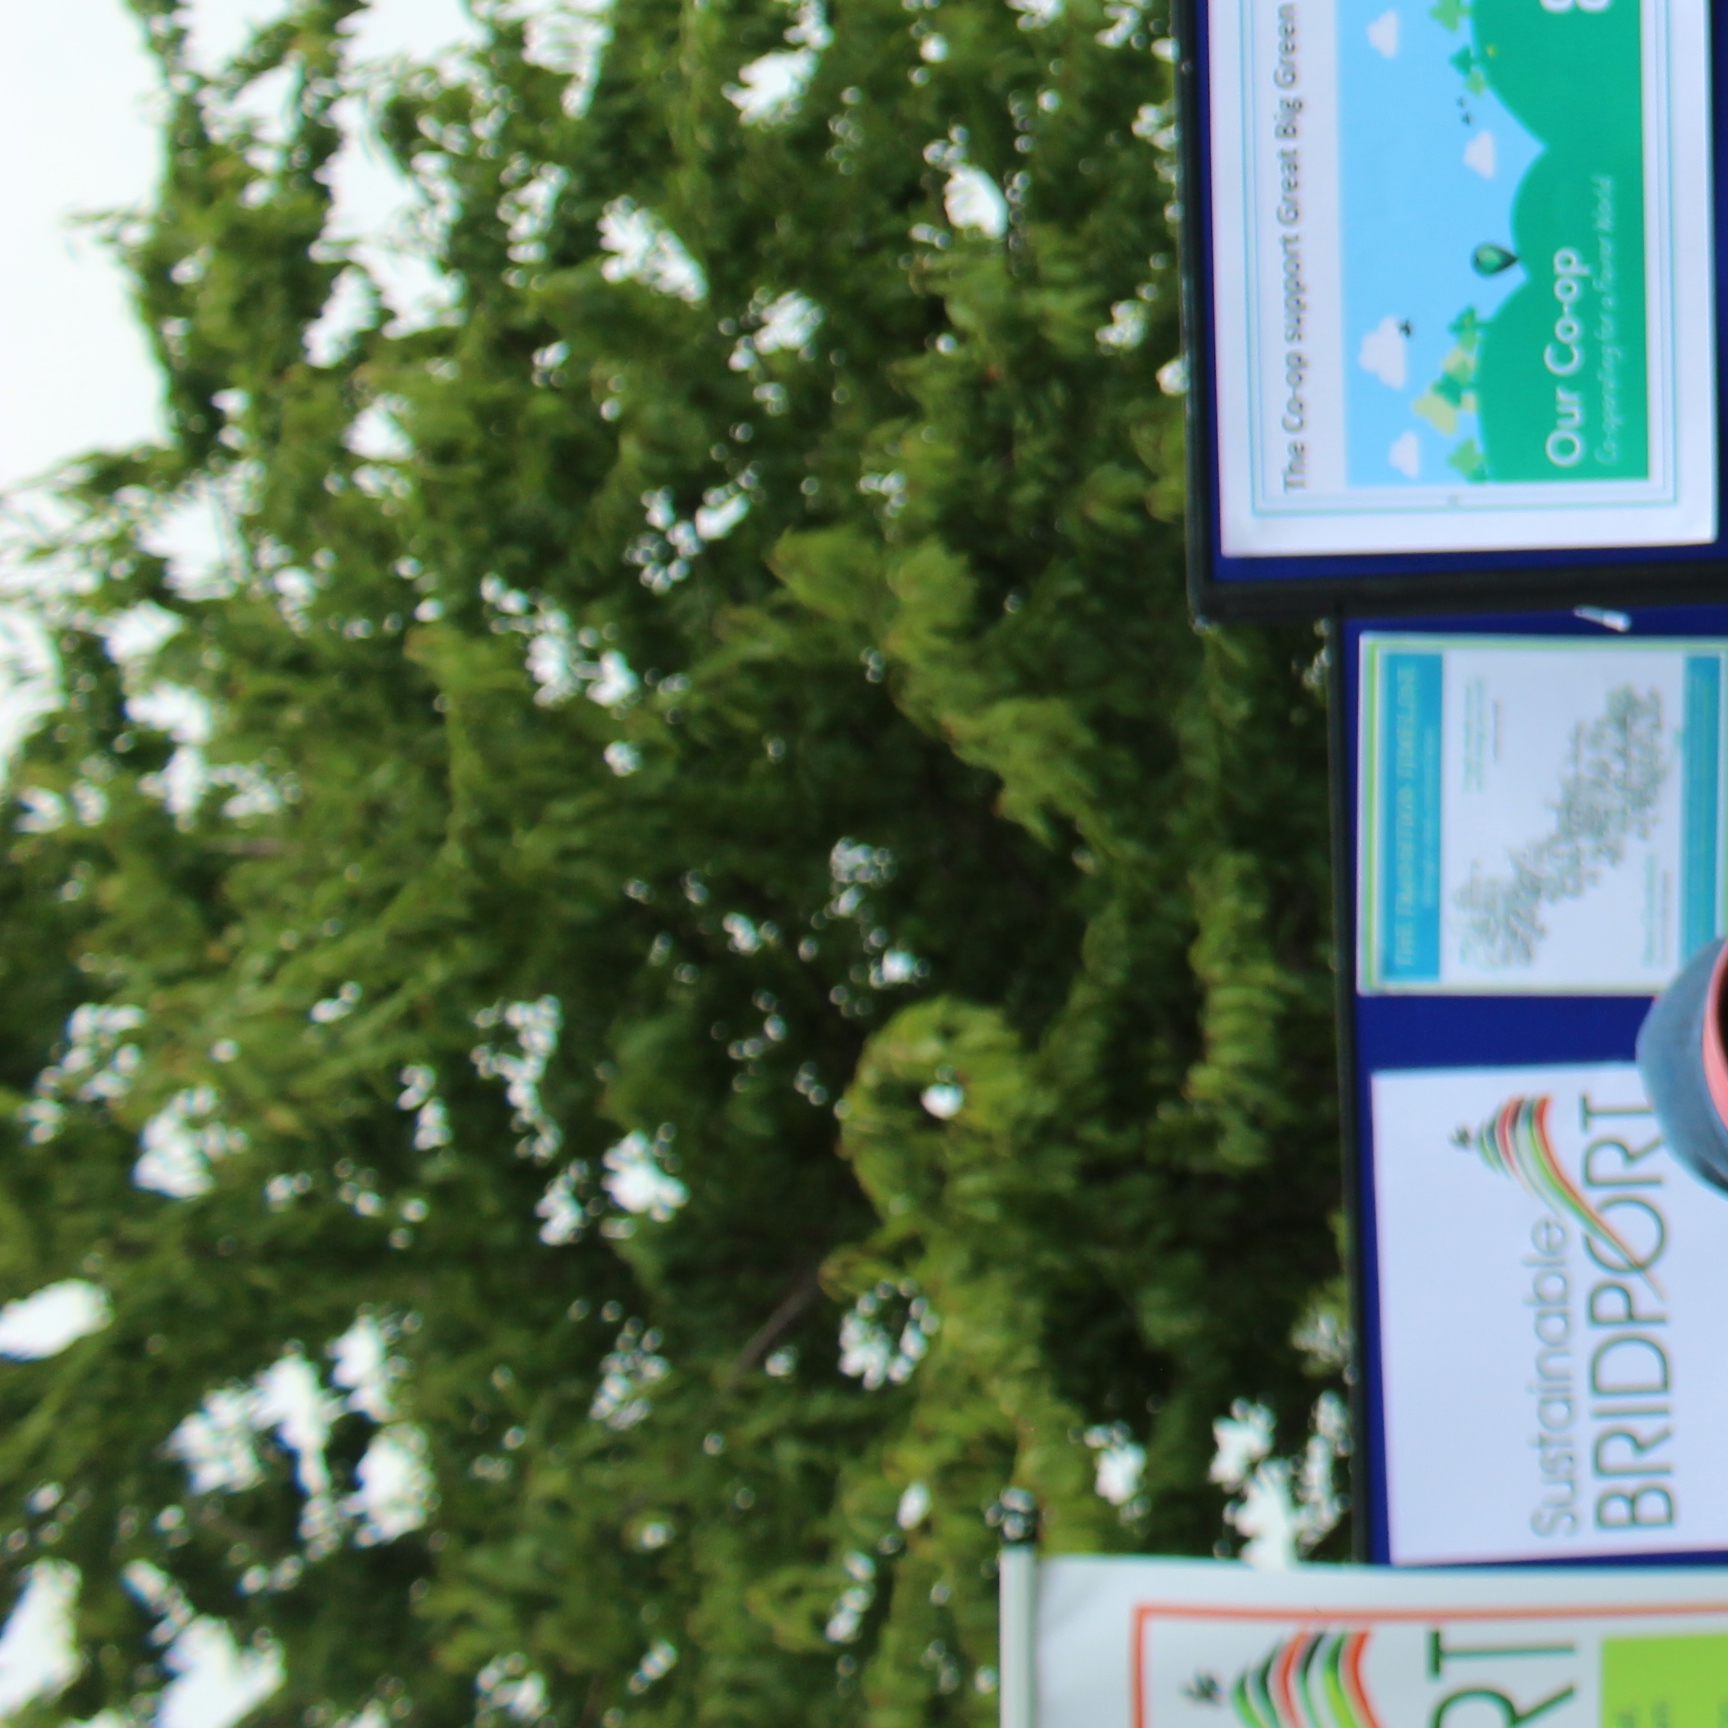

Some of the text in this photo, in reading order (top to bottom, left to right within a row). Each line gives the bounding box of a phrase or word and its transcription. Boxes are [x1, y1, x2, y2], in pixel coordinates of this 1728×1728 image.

[1271, 4, 1299, 88] Green
[1273, 97, 1303, 140] Big
[1274, 147, 1301, 227] Great
[1278, 234, 1305, 342] support
[1281, 352, 1308, 433] Co-op
[1543, 248, 1589, 467] Our Co-op
[1282, 441, 1307, 493] The
[1579, 1093, 1675, 1529] BRIDPORT
[1520, 1215, 1578, 1538] Sustainable
